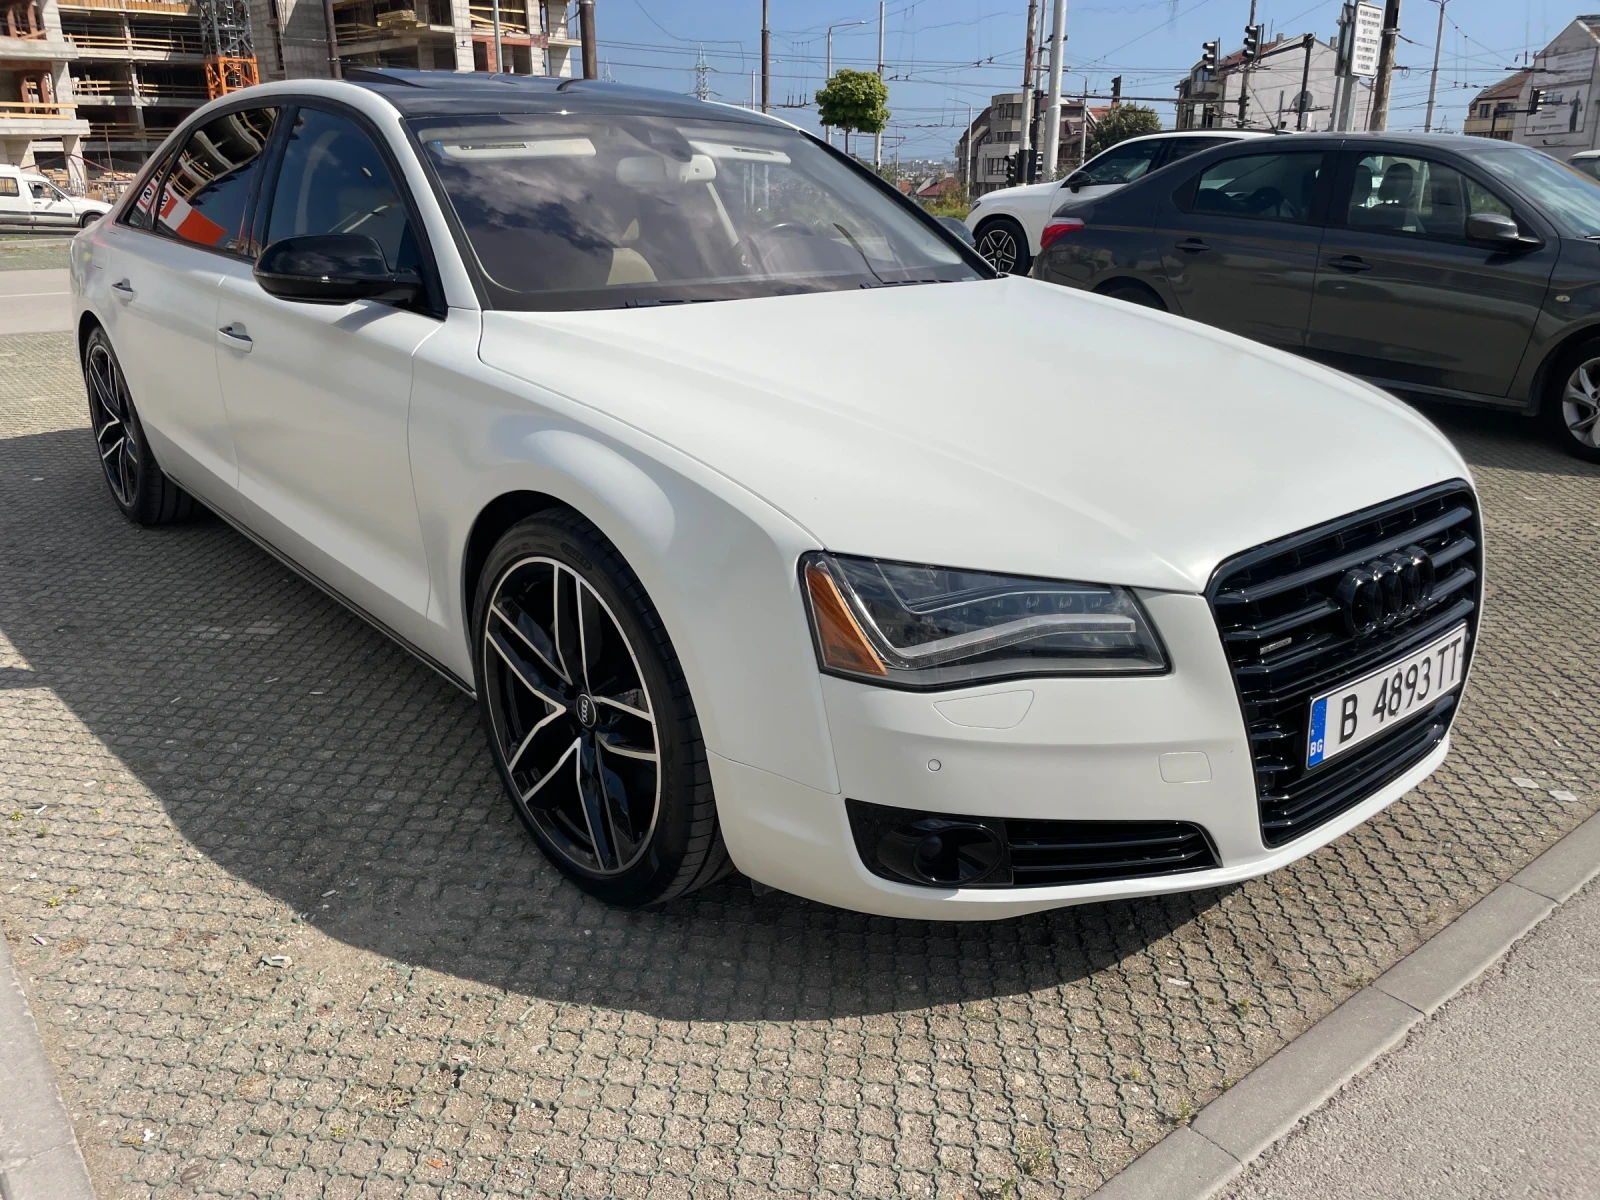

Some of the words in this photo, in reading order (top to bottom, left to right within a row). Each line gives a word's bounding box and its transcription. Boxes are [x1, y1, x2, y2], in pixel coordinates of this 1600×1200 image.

[1338, 693, 1358, 745] B
[1372, 656, 1431, 723] 4893
[1437, 637, 1462, 690] TT
[1310, 739, 1323, 757] BG
